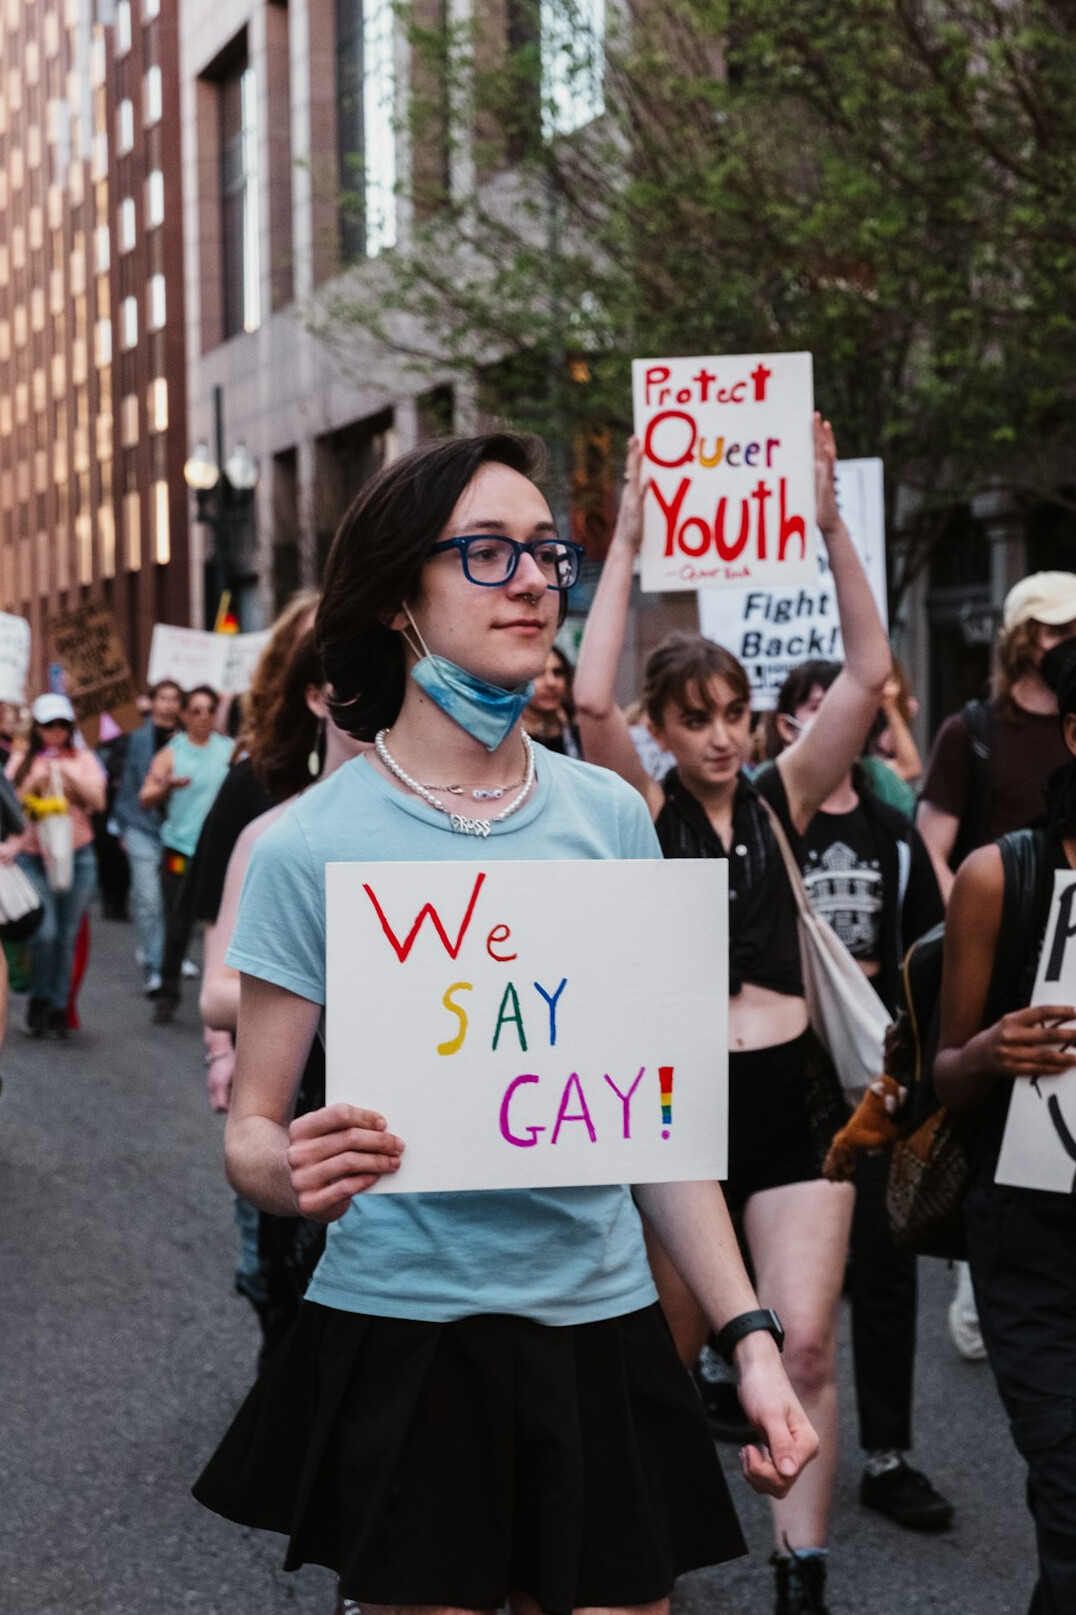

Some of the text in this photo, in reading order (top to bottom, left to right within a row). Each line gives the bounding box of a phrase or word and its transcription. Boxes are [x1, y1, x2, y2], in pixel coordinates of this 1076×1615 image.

[645, 363, 772, 405] Protect
[644, 410, 781, 468] Queer
[744, 590, 828, 623] Fight
[742, 627, 837, 658] Back!
[363, 872, 518, 963] We
[437, 978, 567, 1056] SAY
[499, 1066, 674, 1148] GAY!
